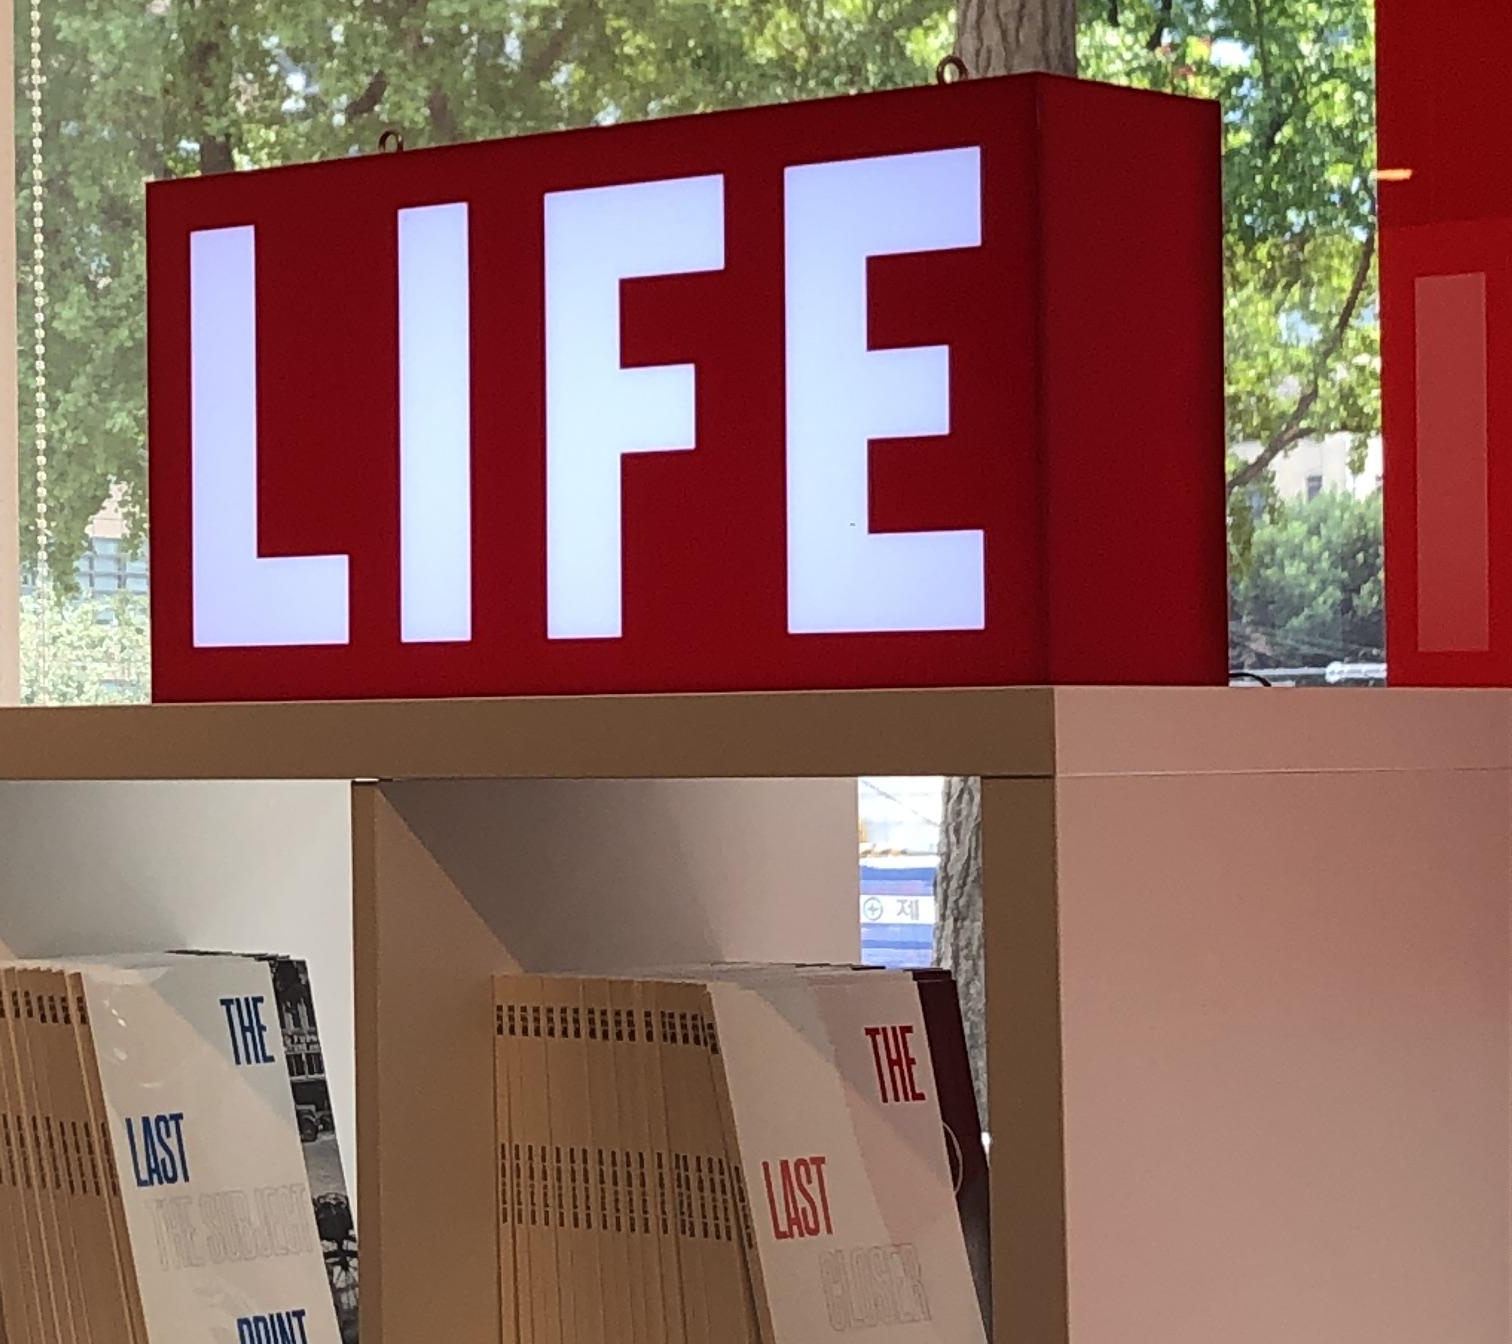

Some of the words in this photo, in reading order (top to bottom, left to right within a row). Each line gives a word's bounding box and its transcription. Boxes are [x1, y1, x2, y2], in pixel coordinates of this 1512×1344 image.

[189, 145, 985, 649] LIFE
[220, 996, 275, 1065] THE
[865, 1025, 926, 1103] THE
[125, 1113, 189, 1188] LAST
[762, 1156, 834, 1240] LAST
